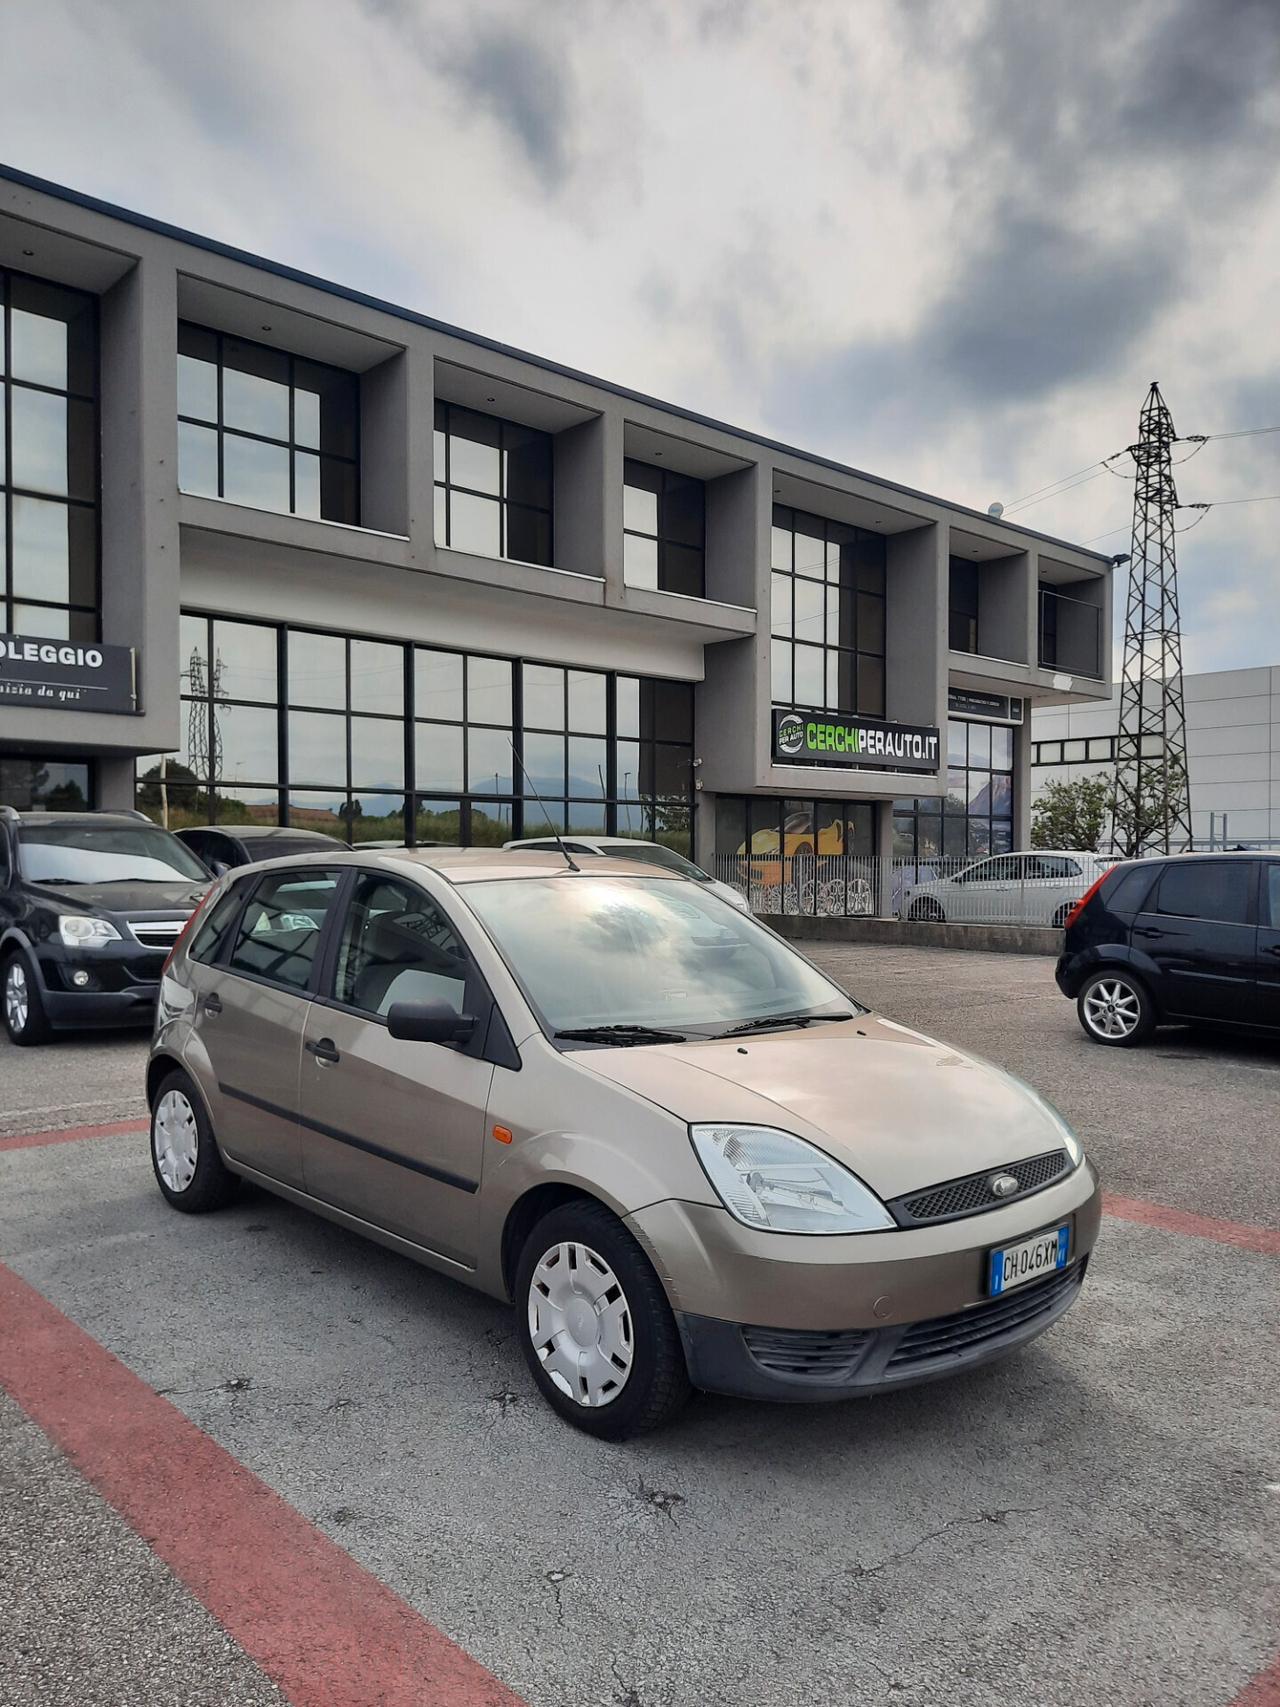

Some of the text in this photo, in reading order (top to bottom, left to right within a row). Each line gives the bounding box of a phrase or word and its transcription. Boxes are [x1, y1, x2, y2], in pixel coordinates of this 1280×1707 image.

[37, 685, 54, 697] da
[779, 724, 804, 738] CERCHI
[790, 731, 804, 742] AUTO
[806, 722, 938, 760] CERCHIPERAUTO.IT
